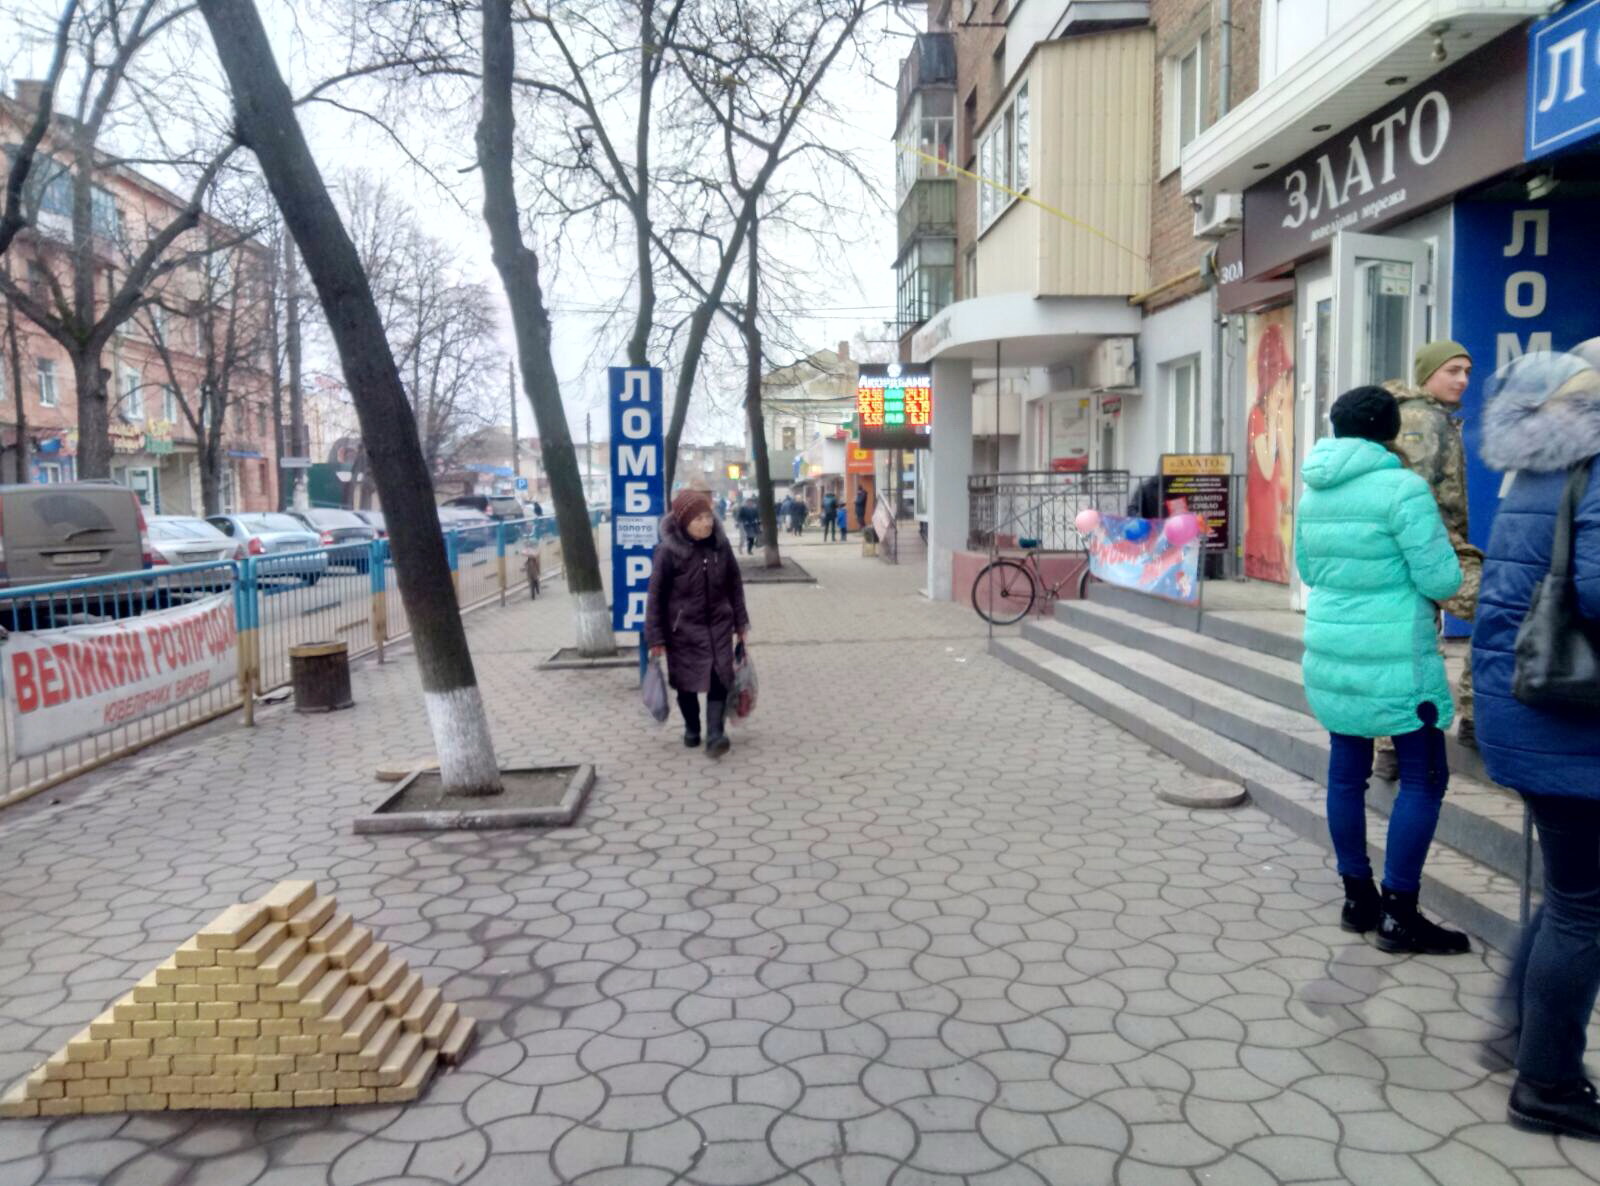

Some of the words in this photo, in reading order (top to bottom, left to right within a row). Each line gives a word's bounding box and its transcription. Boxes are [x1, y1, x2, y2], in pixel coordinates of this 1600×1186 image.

[1538, 28, 1600, 113] Л
[1282, 91, 1450, 228] ЗЛАТО
[617, 370, 657, 629] ЛОМБРД
[12, 623, 150, 714] ВЕЛИКИЙ
